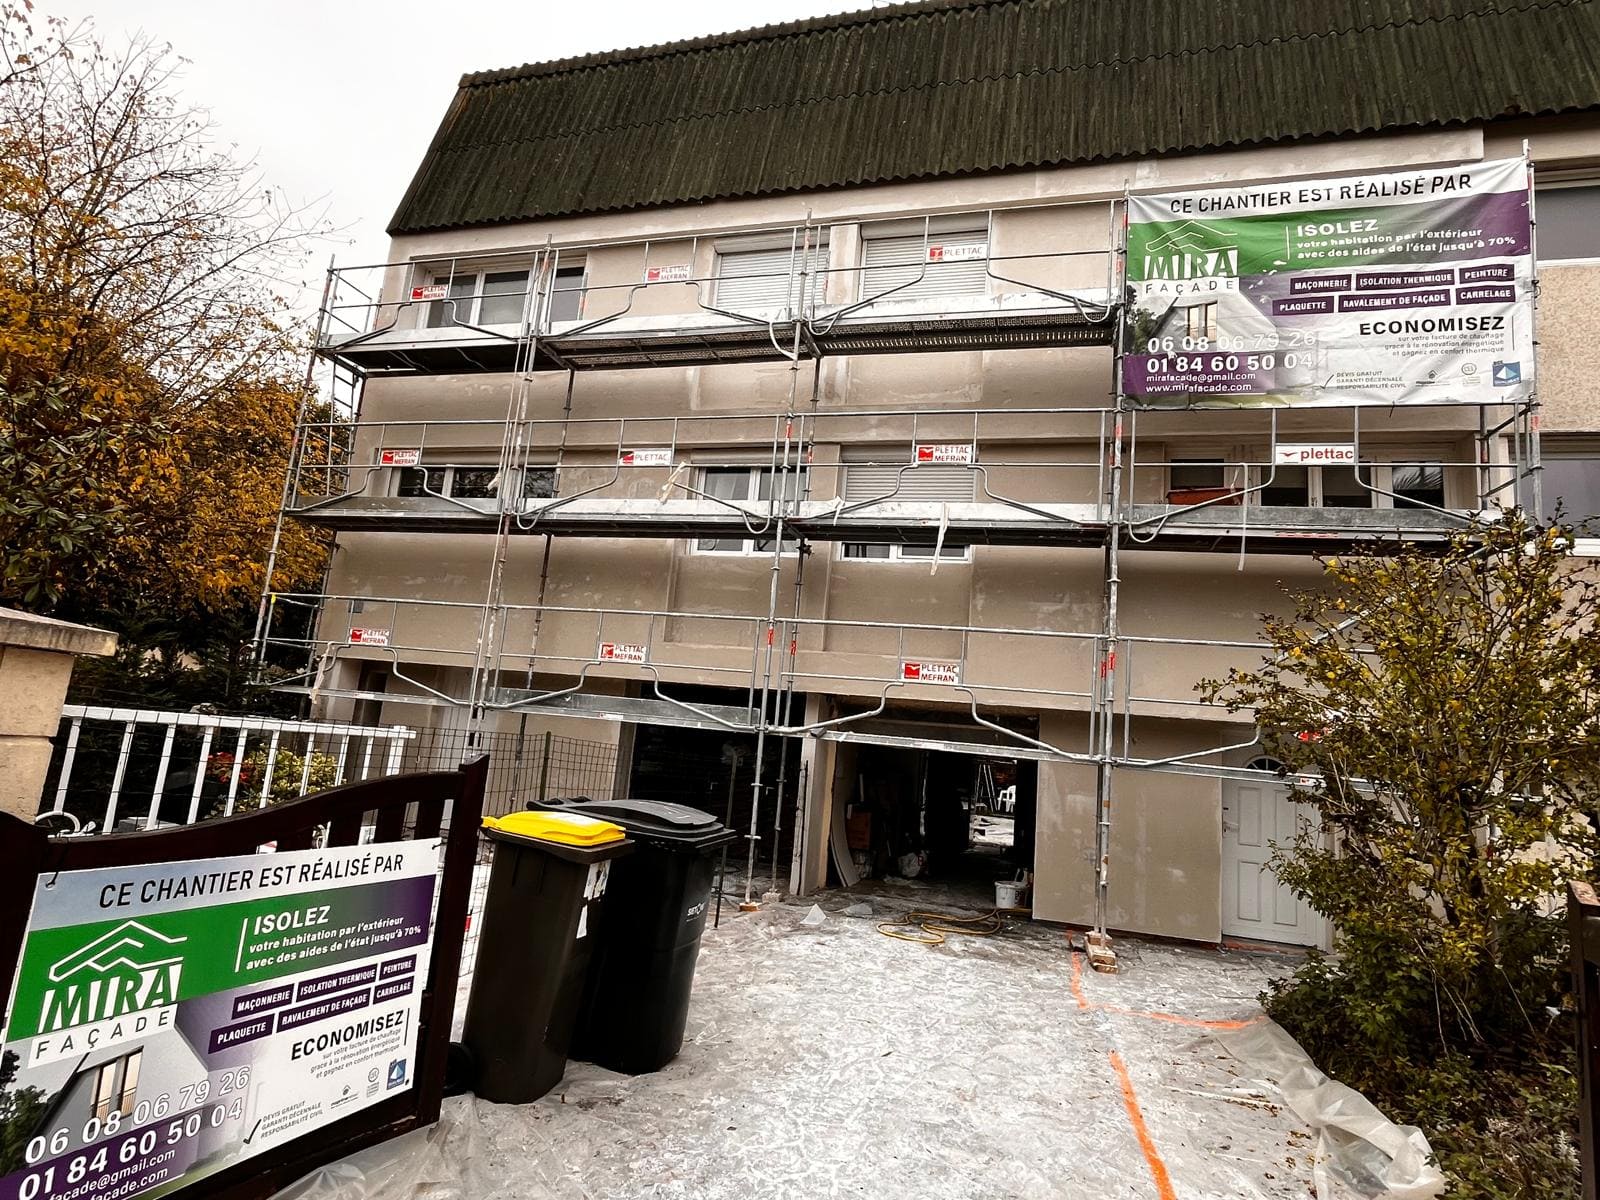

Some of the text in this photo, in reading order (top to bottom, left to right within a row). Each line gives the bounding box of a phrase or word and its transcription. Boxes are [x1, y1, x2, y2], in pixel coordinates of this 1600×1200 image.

[1170, 174, 1472, 214] CE CHANTIER EST RÉALISÉ PAR
[1297, 219, 1379, 237] ISOLEZ
[1297, 240, 1328, 249] votre
[1331, 235, 1393, 246] habitation
[1395, 232, 1418, 243] par
[1297, 251, 1325, 259] avec
[1327, 249, 1349, 257] des
[1352, 247, 1385, 256] aides
[1388, 244, 1403, 253] de
[1487, 236, 1516, 246] 70%
[944, 247, 983, 256] PLETTAC
[661, 265, 689, 273] PLETTAC
[1144, 250, 1239, 280] MIRA
[1464, 268, 1508, 279] PEINTURE
[1145, 280, 1234, 297] FAÇADE
[1294, 279, 1348, 290] MAÇONNERIE
[1360, 274, 1452, 287] ISOLATION THERMIQUE
[1343, 293, 1446, 308] RAVALEMENT DE FAÇADE
[1460, 289, 1511, 299] CARRELAGE
[1279, 301, 1327, 311] PLAQUETTE
[1359, 316, 1505, 336] ECONOMISEZ
[1147, 336, 1174, 353] 06
[1182, 335, 1209, 351] 08
[1216, 335, 1244, 351] 06
[1288, 331, 1316, 347] 26
[1146, 353, 1313, 373] 01 84 60 50 04
[1146, 372, 1256, 383] mirafacade@gmail.com
[1145, 383, 1252, 392] www.mirafacade.com
[635, 453, 669, 461] PLETTAC
[1300, 448, 1354, 461] plettac
[921, 664, 957, 673] PLETTAC
[921, 673, 955, 682] MEFRAN
[99, 853, 404, 908] CE CHANTIER EST RÉALISÉ PAR
[254, 905, 331, 935] ISOLEZ
[246, 957, 274, 970] avec
[276, 952, 297, 963] des
[299, 945, 328, 959] aides
[330, 941, 343, 952] de
[404, 925, 421, 936] 70%
[249, 940, 280, 953] votre
[282, 929, 337, 947] habitation
[339, 926, 356, 938] par
[383, 960, 413, 974] PEINTURE
[300, 969, 376, 996] ISOLATION THERMIQUE
[376, 982, 411, 998] CARRELAGE
[38, 964, 182, 1034] MIRA
[237, 990, 291, 1012] MAÇONNERIE
[282, 994, 368, 1026] RAVALEMENT DE FAÇADE
[36, 1010, 170, 1060] FAÇADE
[217, 1022, 267, 1045] PLAQUETTE
[291, 1010, 404, 1061] ECONOMISEZ
[25, 1066, 250, 1164] 06 08 06 79 26
[18, 1097, 243, 1200] 01 84 60 50 04
